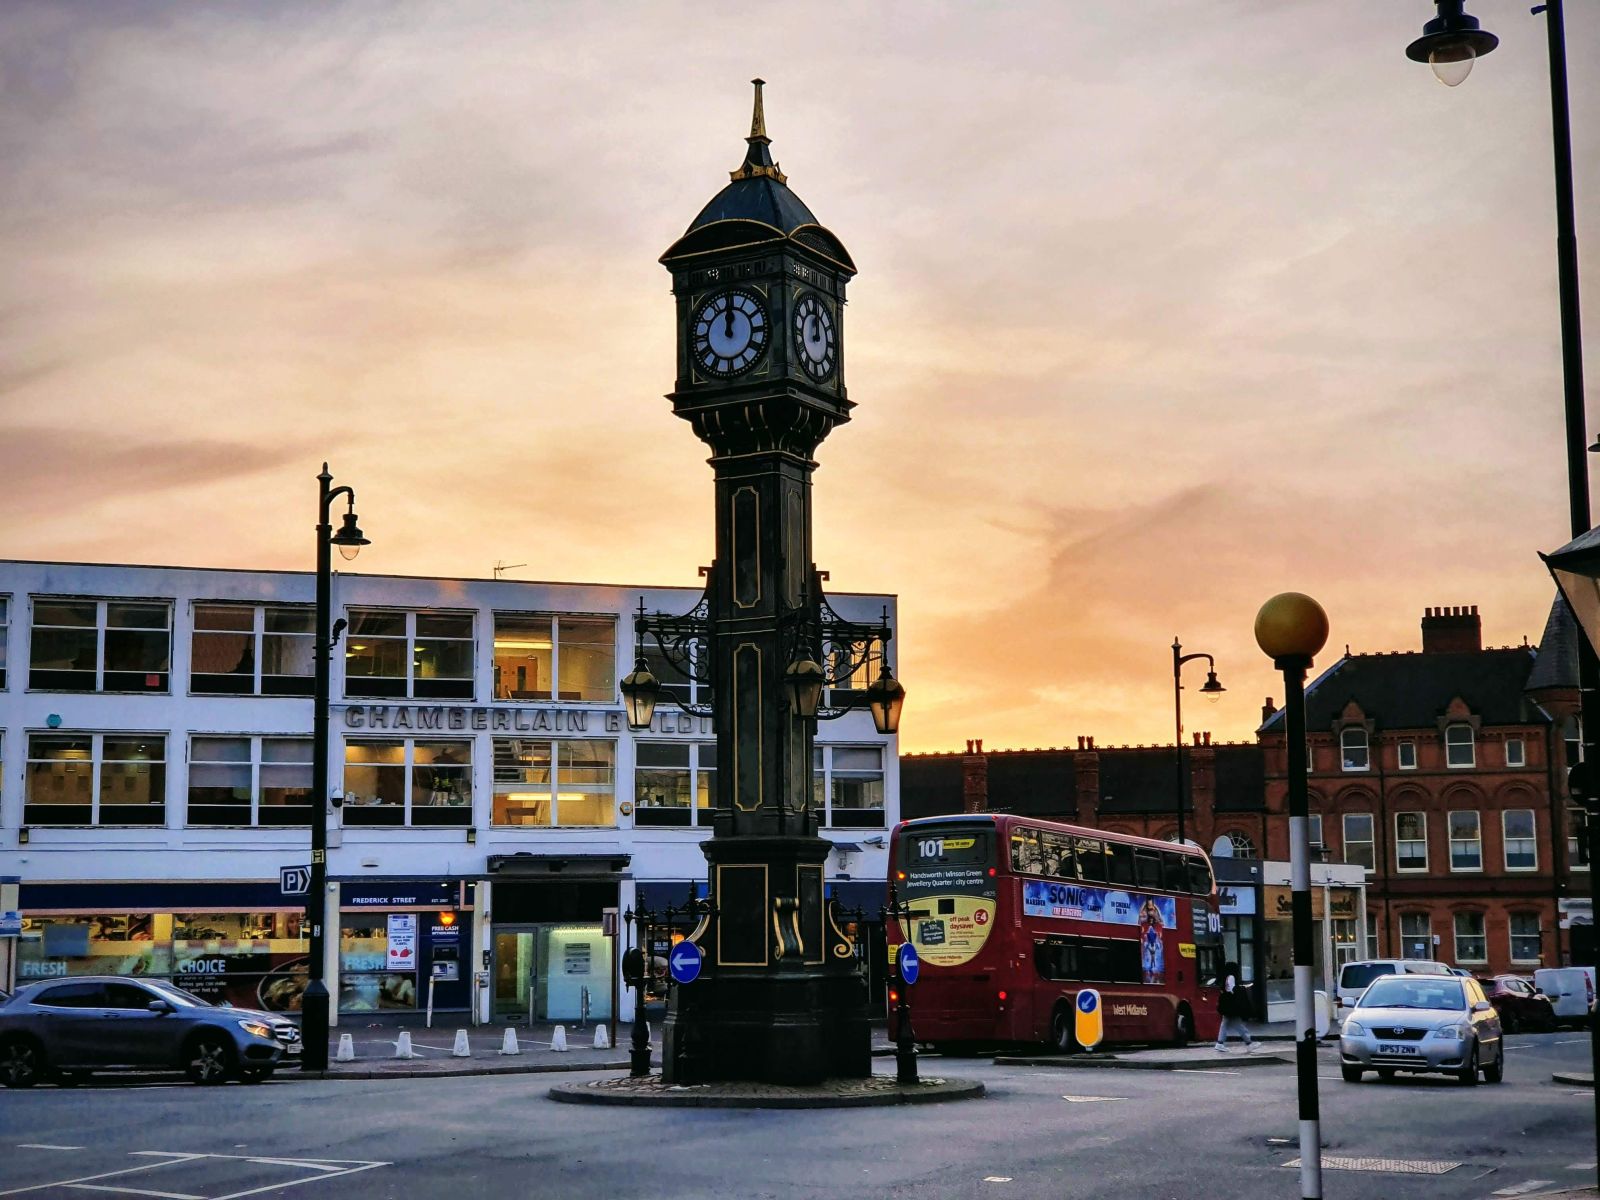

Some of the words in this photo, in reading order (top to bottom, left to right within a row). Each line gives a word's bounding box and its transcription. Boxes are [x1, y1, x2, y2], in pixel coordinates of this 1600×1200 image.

[345, 704, 588, 734] CHAMBERLAIN
[918, 840, 944, 858] 101
[287, 873, 296, 890] P
[910, 872, 943, 880] Handsworth
[945, 870, 966, 878] Winson
[966, 869, 982, 877] Green
[1049, 884, 1087, 907] SONIC
[975, 912, 987, 922] £4
[1207, 912, 1221, 933] 101
[23, 961, 67, 976] FRESH
[178, 959, 226, 973] CHOICE
[1113, 1004, 1126, 1016] West
[1126, 1004, 1148, 1016] Midlands
